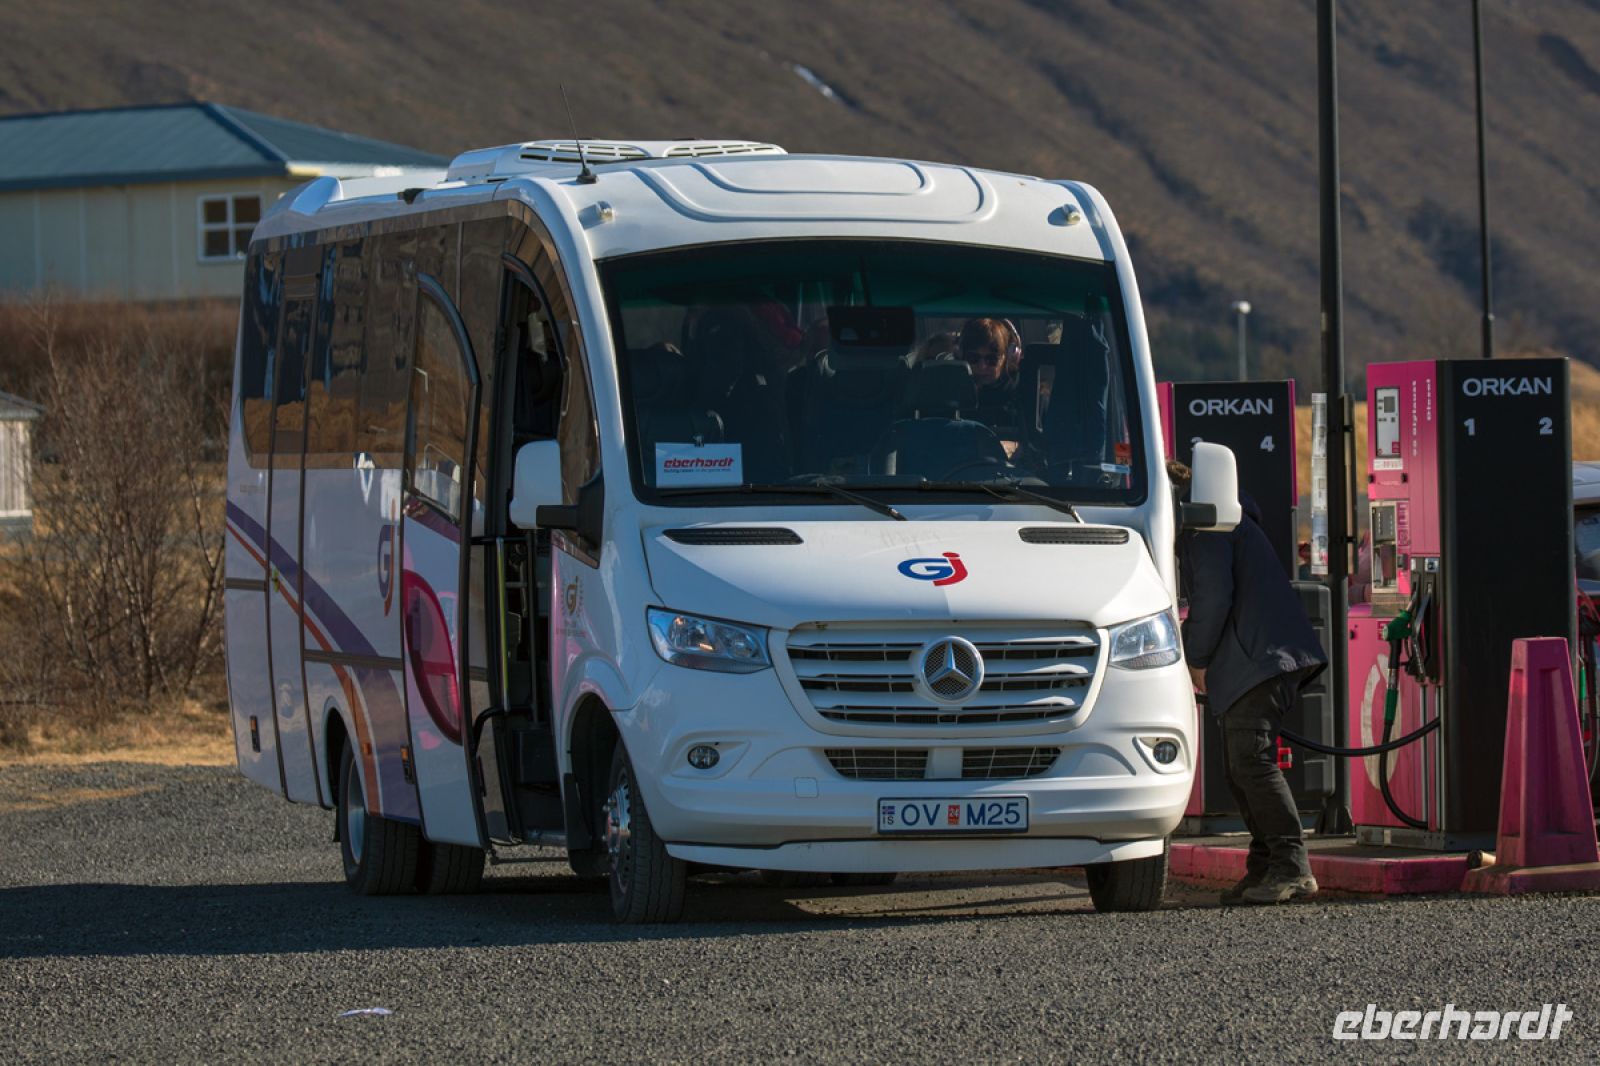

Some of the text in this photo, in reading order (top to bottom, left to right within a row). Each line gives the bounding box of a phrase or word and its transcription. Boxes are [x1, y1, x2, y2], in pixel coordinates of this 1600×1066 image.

[1462, 377, 1552, 396] ORKAN
[1188, 398, 1273, 416] ORKAN
[1463, 416, 1553, 436] 1 2
[1260, 435, 1275, 452] 4
[663, 457, 734, 469] eberhardt
[882, 815, 894, 825] IS
[901, 802, 1021, 826] OV M25
